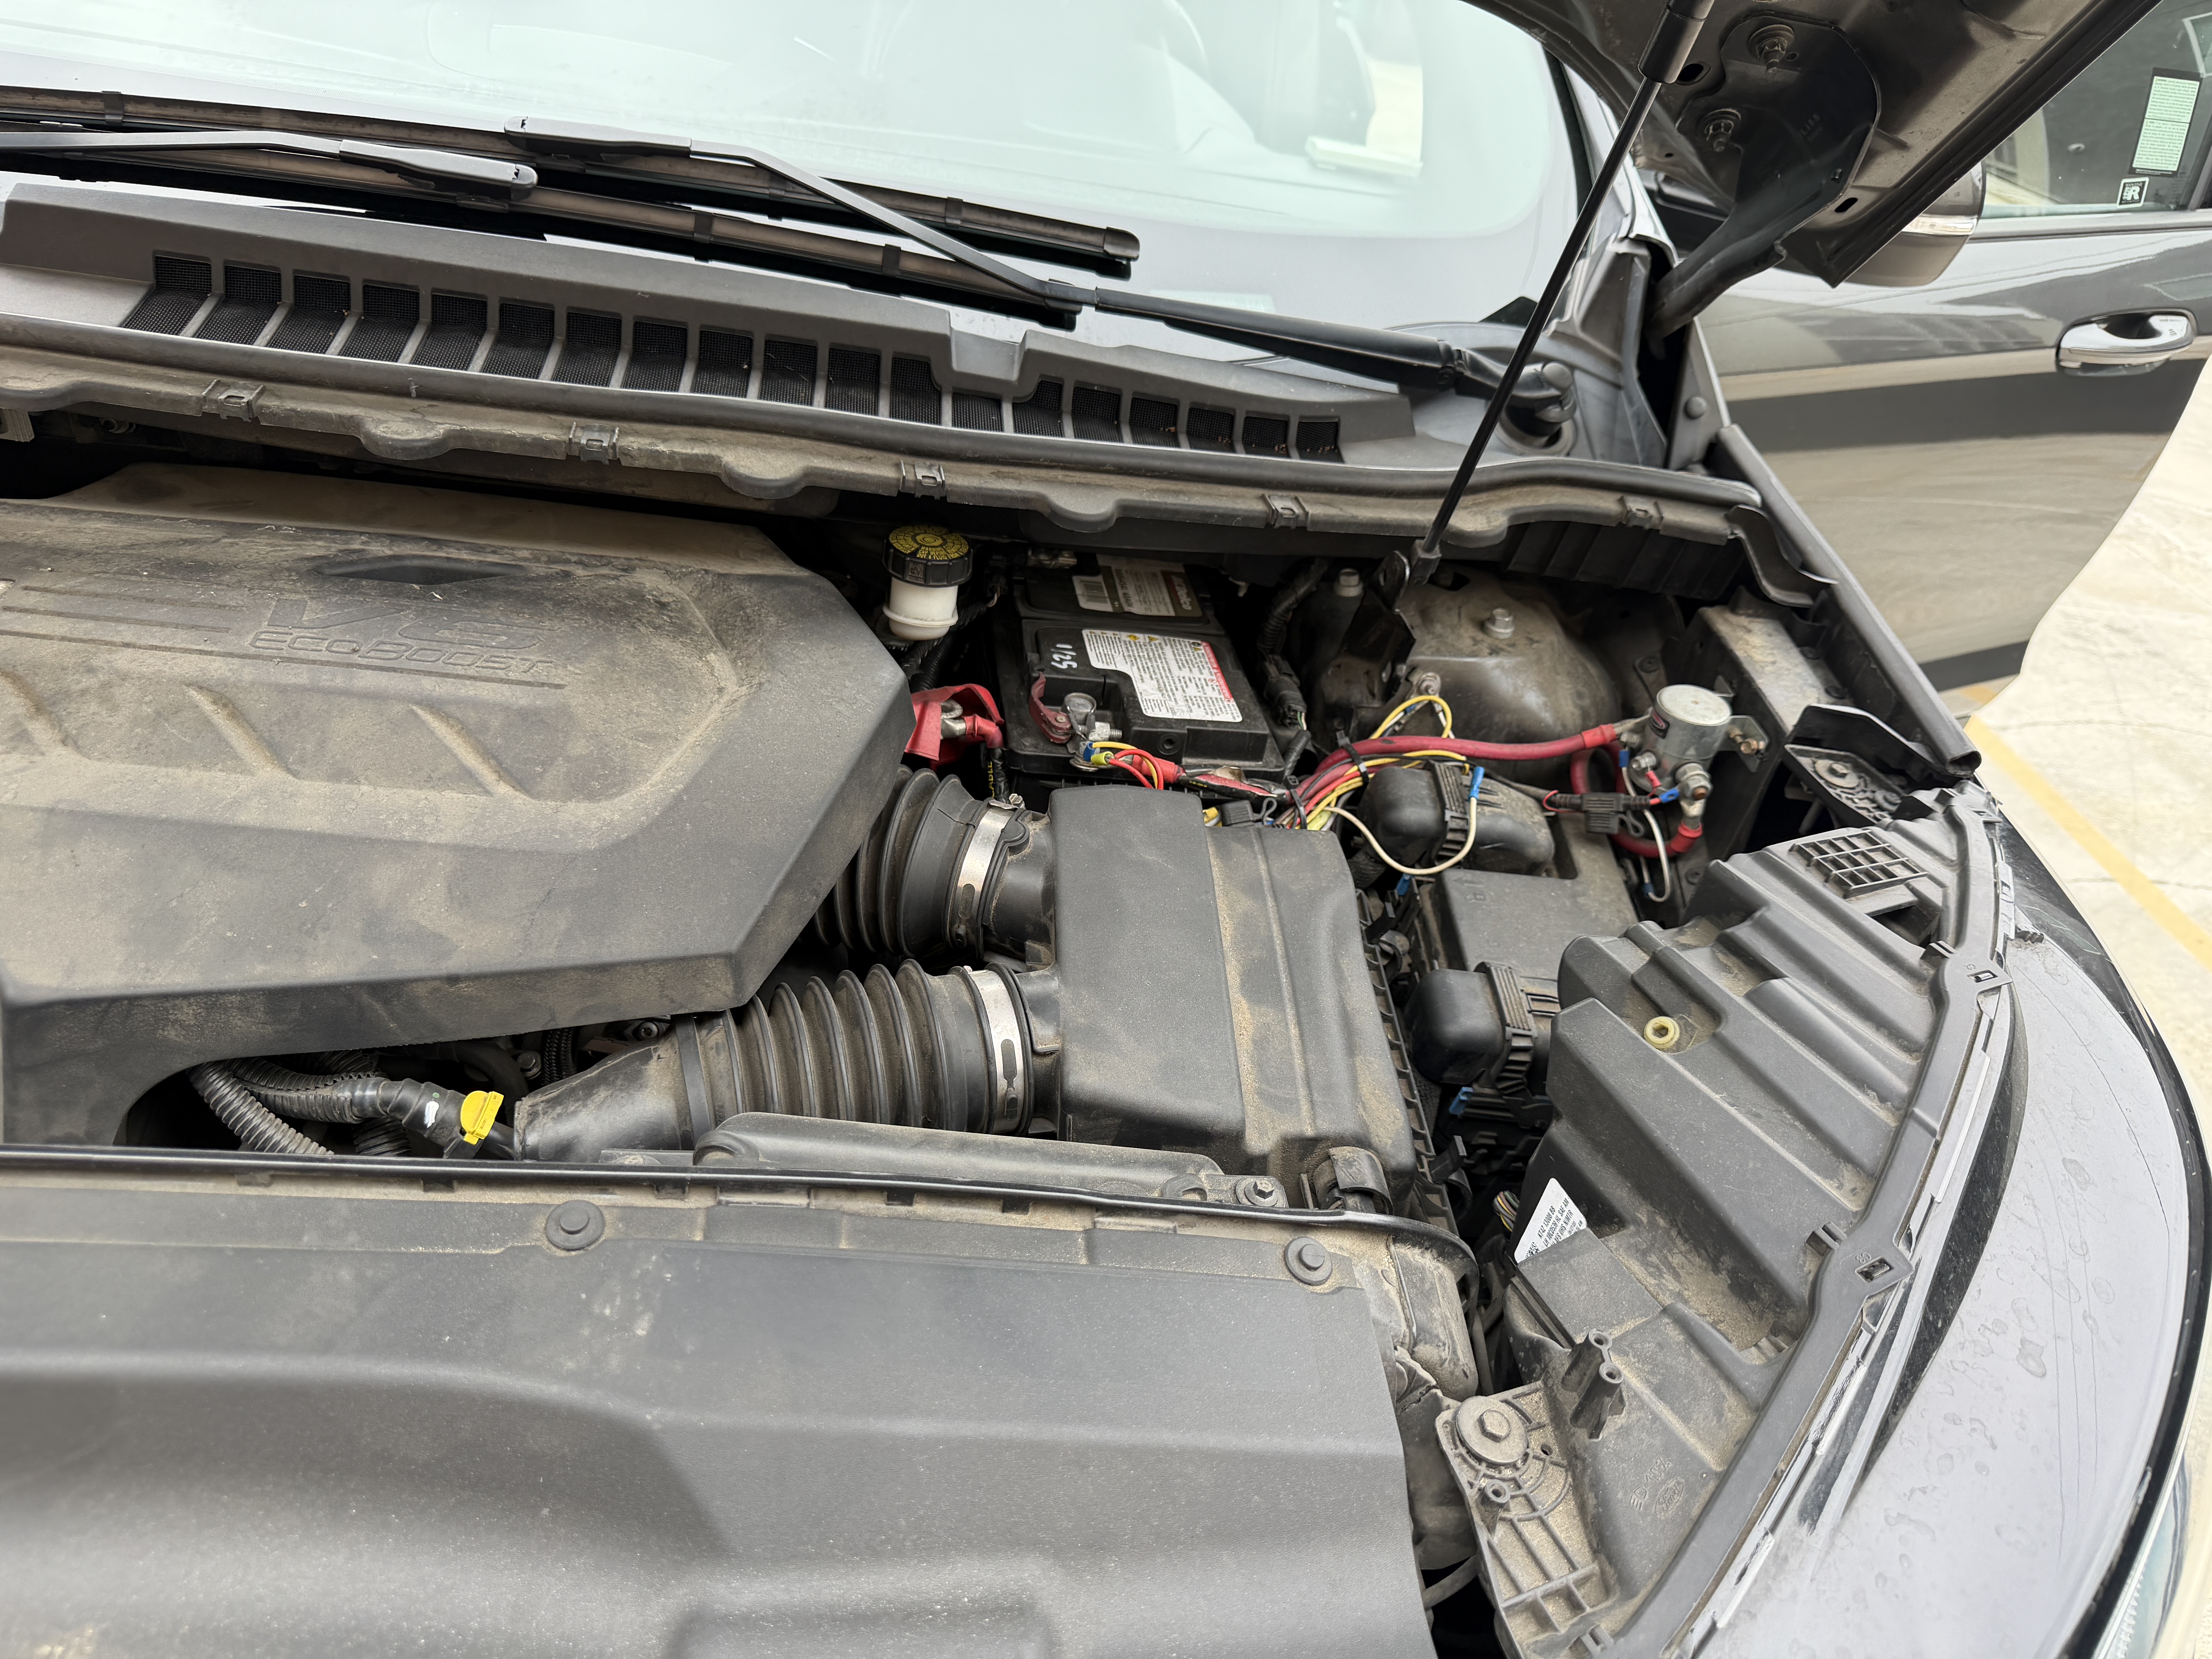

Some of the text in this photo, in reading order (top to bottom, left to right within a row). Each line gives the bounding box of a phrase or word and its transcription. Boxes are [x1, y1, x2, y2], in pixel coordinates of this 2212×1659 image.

[1051, 643, 1077, 669] 1/25
[1543, 1238, 1549, 1247] LH
[1555, 1215, 1561, 1223] HL
